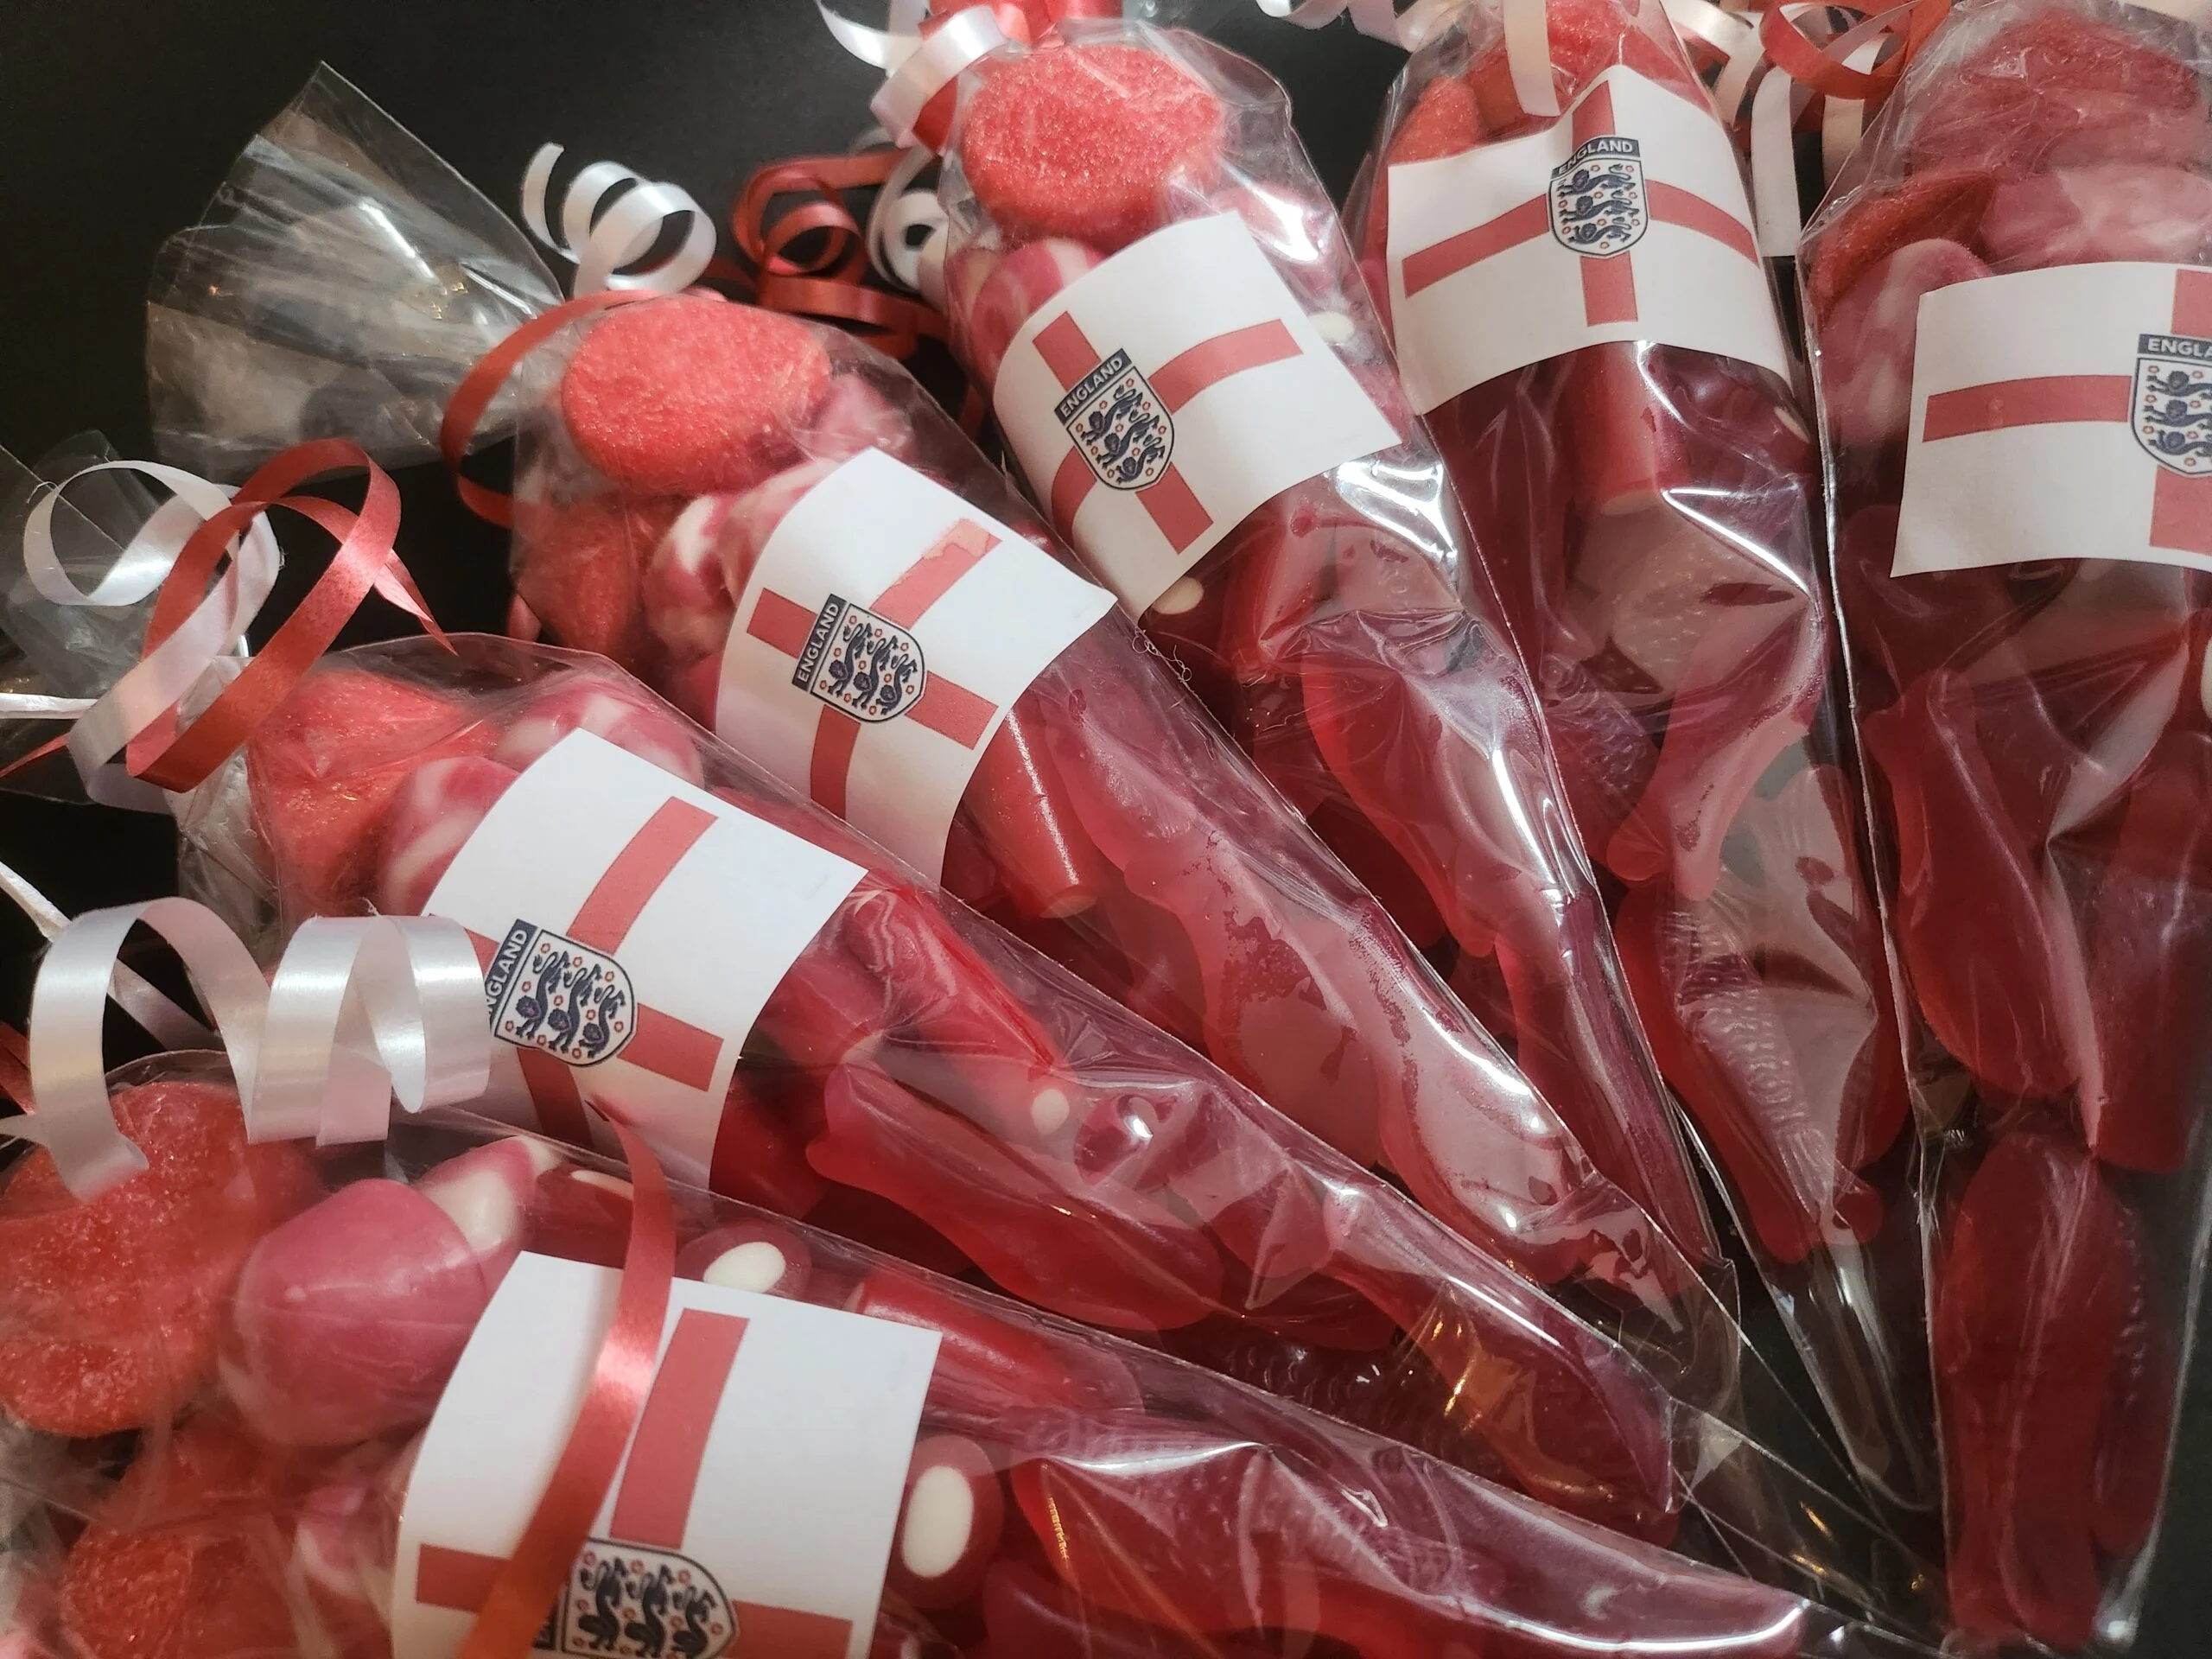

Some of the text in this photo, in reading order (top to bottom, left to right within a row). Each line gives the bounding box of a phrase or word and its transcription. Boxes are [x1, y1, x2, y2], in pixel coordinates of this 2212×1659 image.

[1559, 140, 1632, 175] ENGLAND
[1060, 357, 1122, 417] ENGLAND
[798, 603, 838, 683] ENGLAND
[486, 929, 527, 1012] NGLAND
